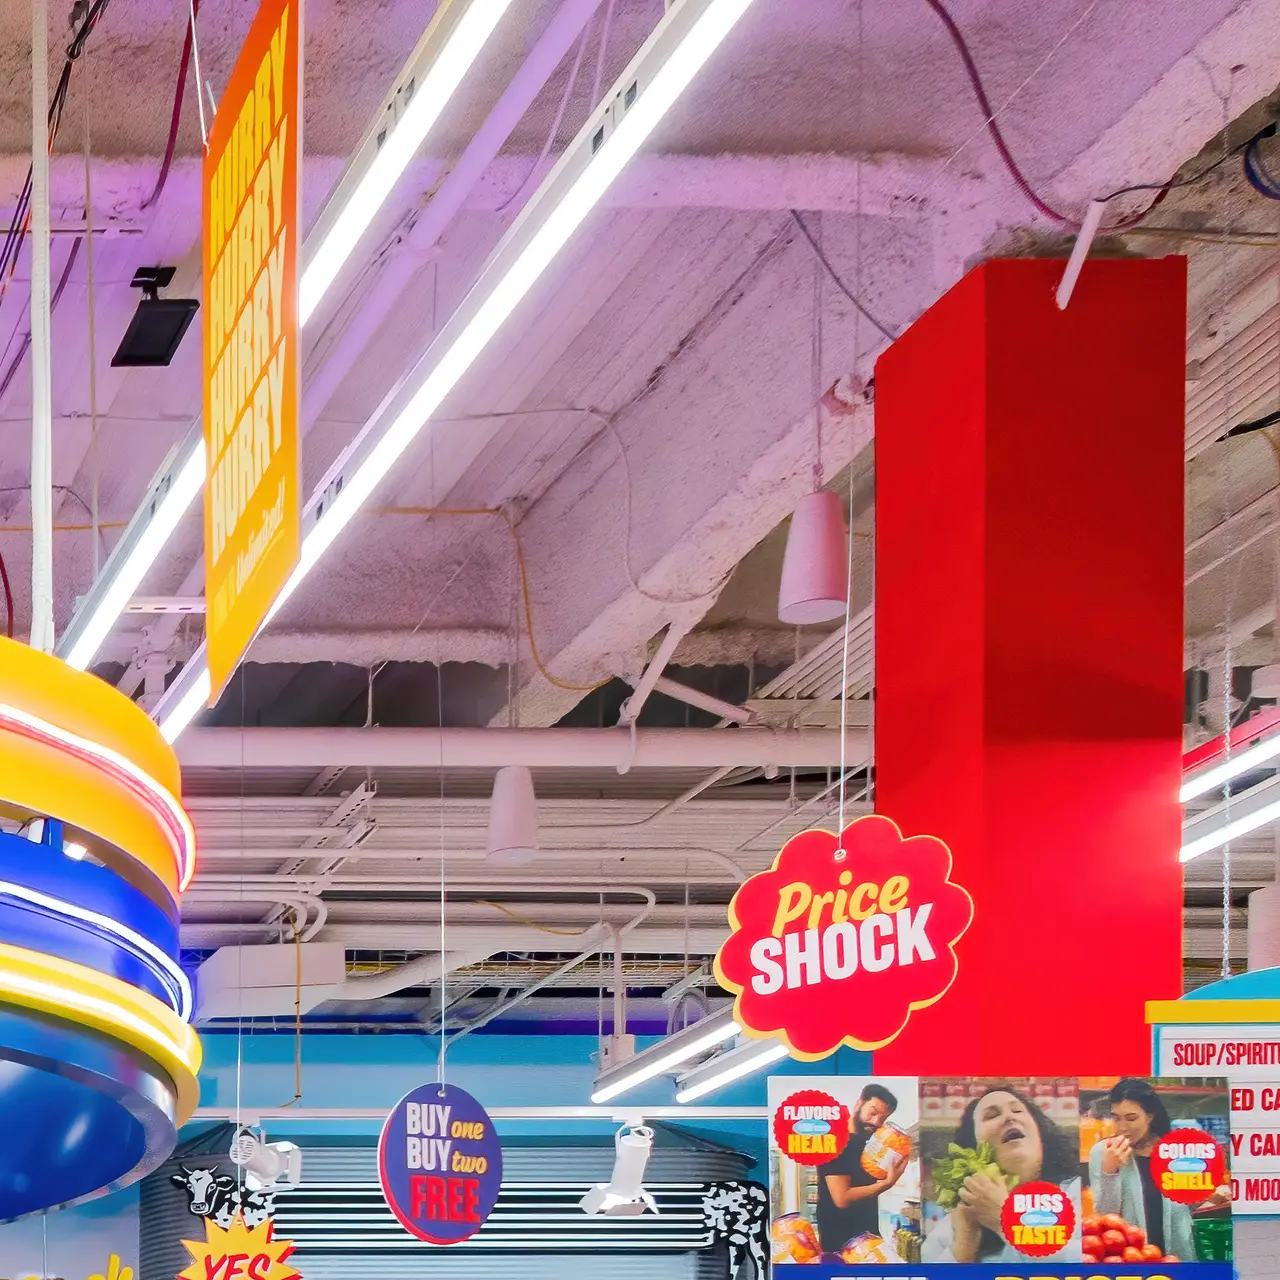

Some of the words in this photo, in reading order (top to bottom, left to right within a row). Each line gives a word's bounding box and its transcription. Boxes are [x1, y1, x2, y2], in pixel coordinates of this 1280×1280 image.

[211, 4, 289, 268] HURRY
[211, 112, 288, 377] HURRY
[211, 223, 287, 471] HURRY
[212, 335, 286, 567] HURRY
[771, 870, 909, 937] Price
[749, 902, 936, 996] SHOCK
[406, 1103, 452, 1137] BUY
[451, 1121, 485, 1140] one
[783, 1104, 840, 1121] FLAVORS
[406, 1137, 452, 1171] BUY
[452, 1150, 488, 1174] two
[788, 1134, 837, 1154] HEAR
[1159, 1143, 1216, 1159] COLORS
[410, 1175, 481, 1222] FREE
[1161, 1172, 1215, 1190] SMELL
[1013, 1193, 1063, 1213] BLISS
[1012, 1225, 1068, 1245] TASTE
